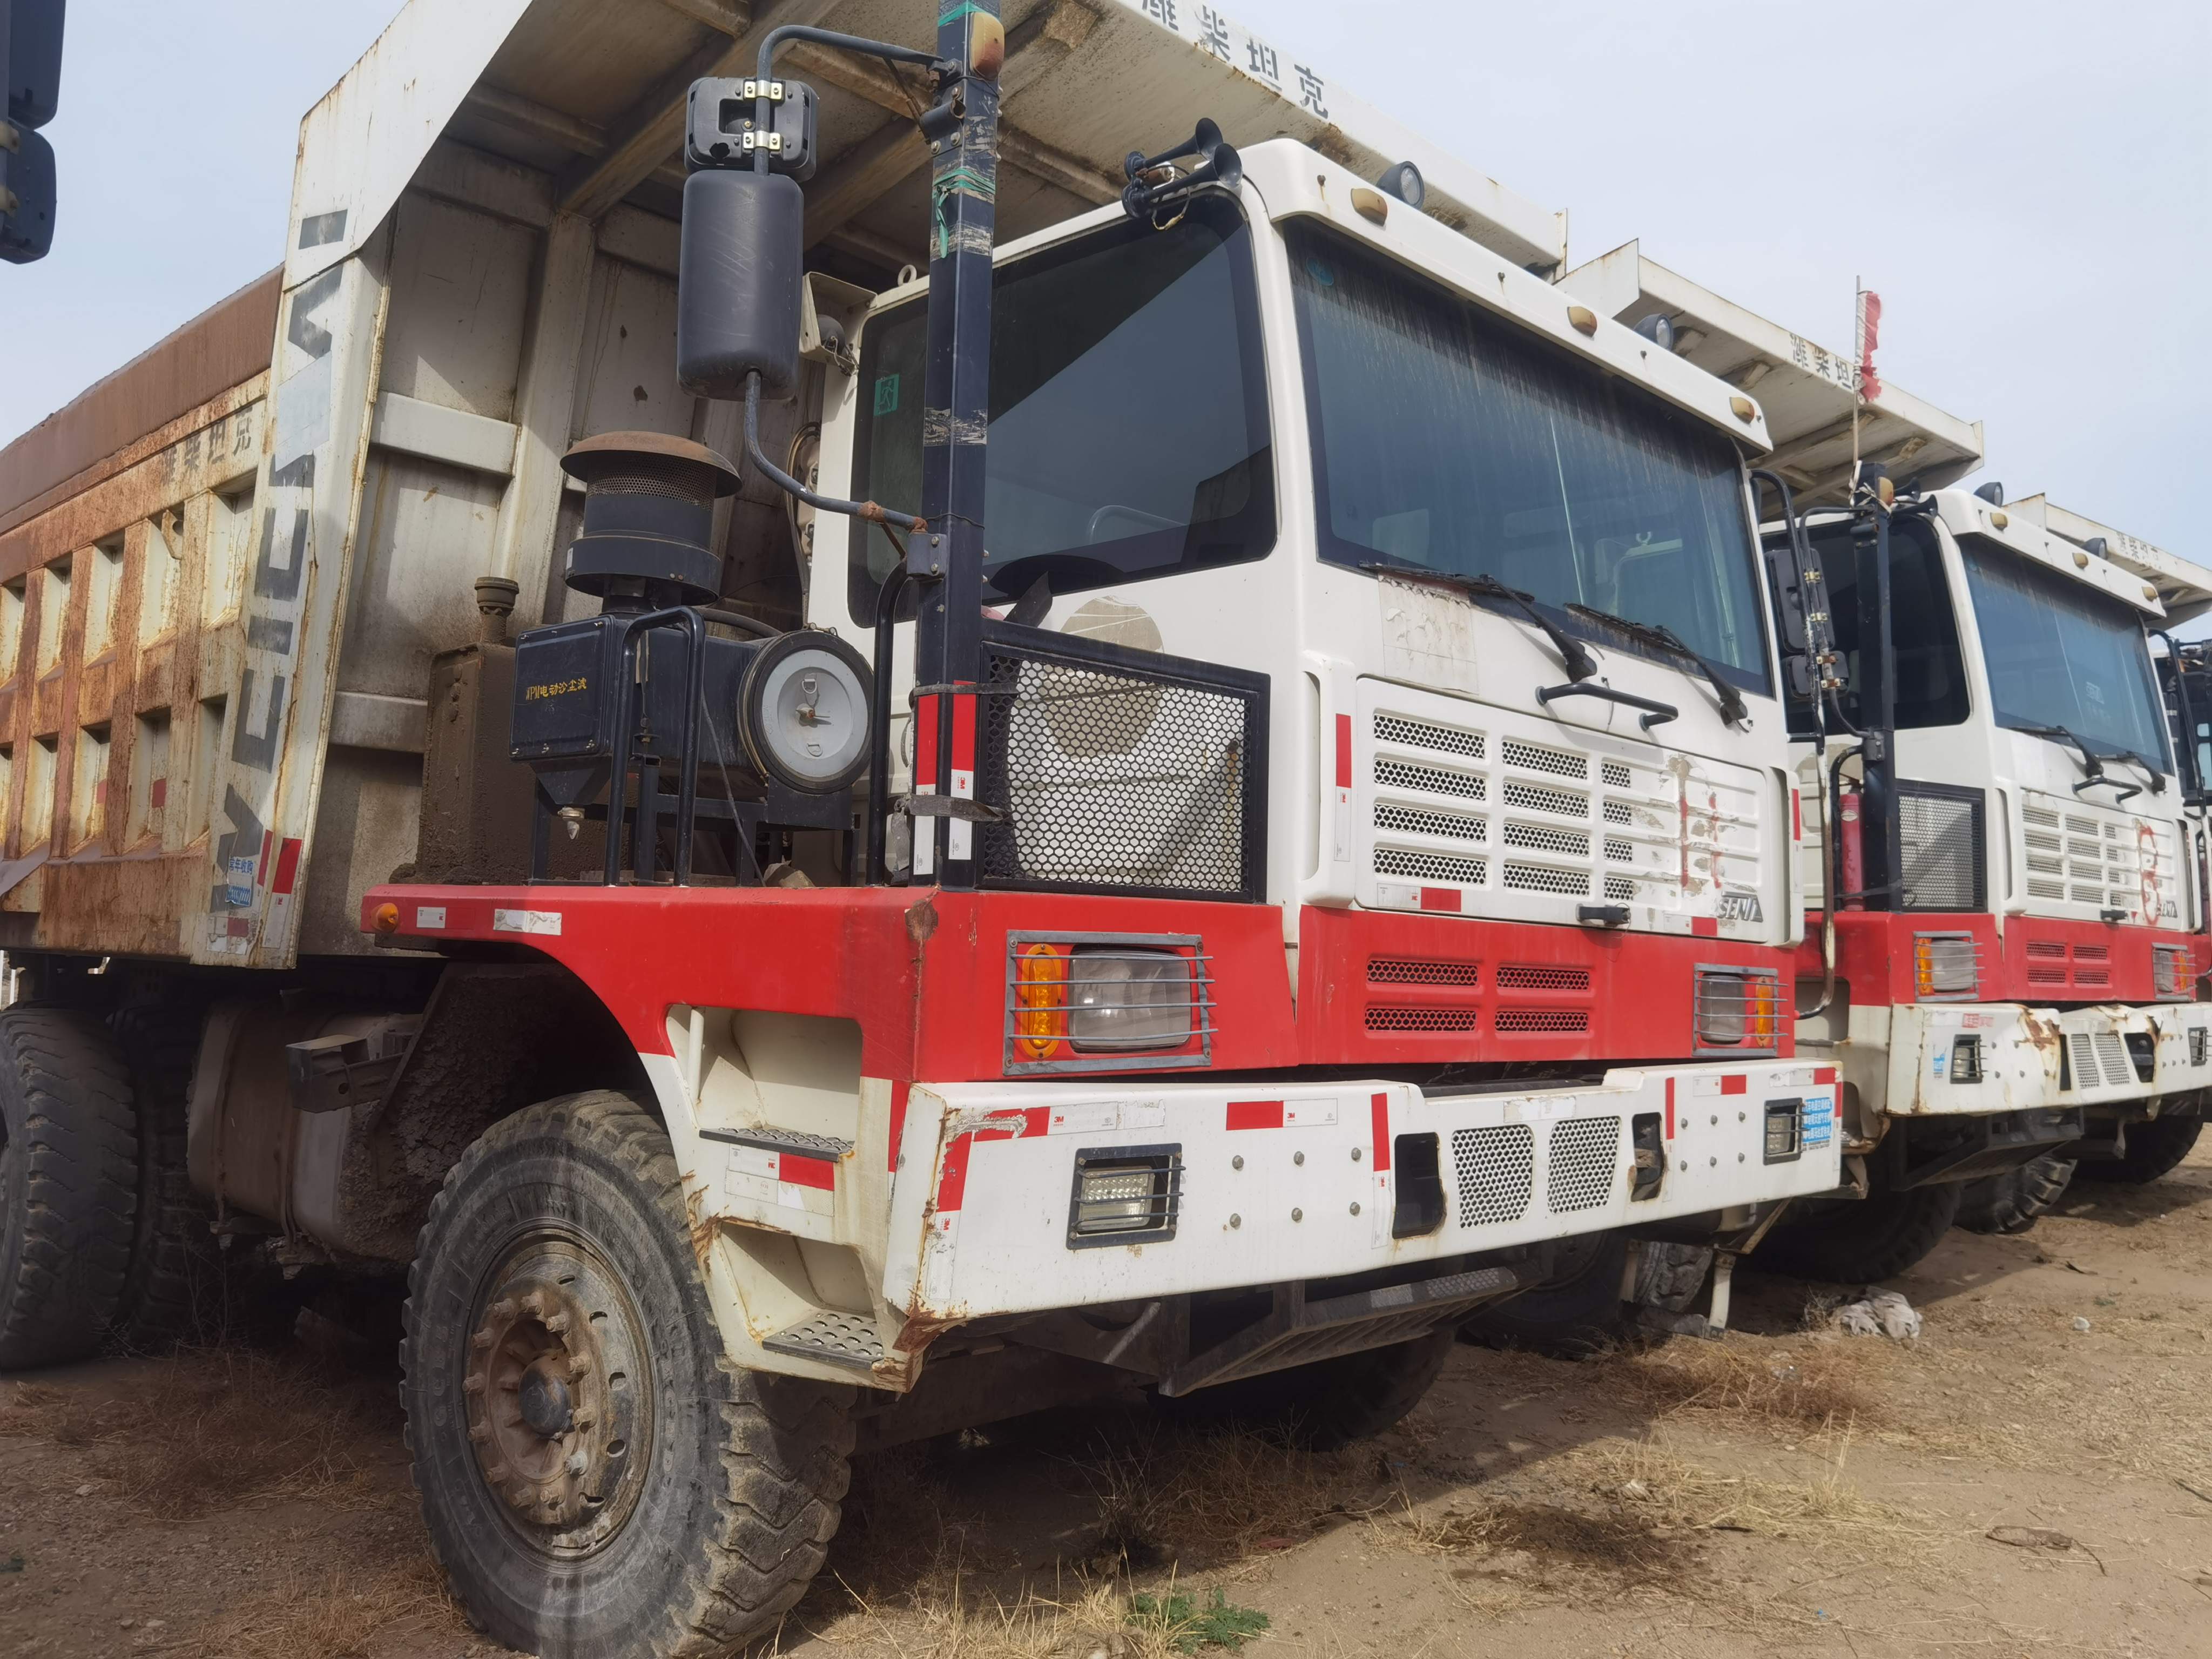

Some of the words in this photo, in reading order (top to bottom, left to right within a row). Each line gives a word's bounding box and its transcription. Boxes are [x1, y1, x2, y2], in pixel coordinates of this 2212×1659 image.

[1789, 333, 1854, 390] 潍柴坦
[960, 777, 966, 790] 3M
[943, 1218, 950, 1230] 3M
